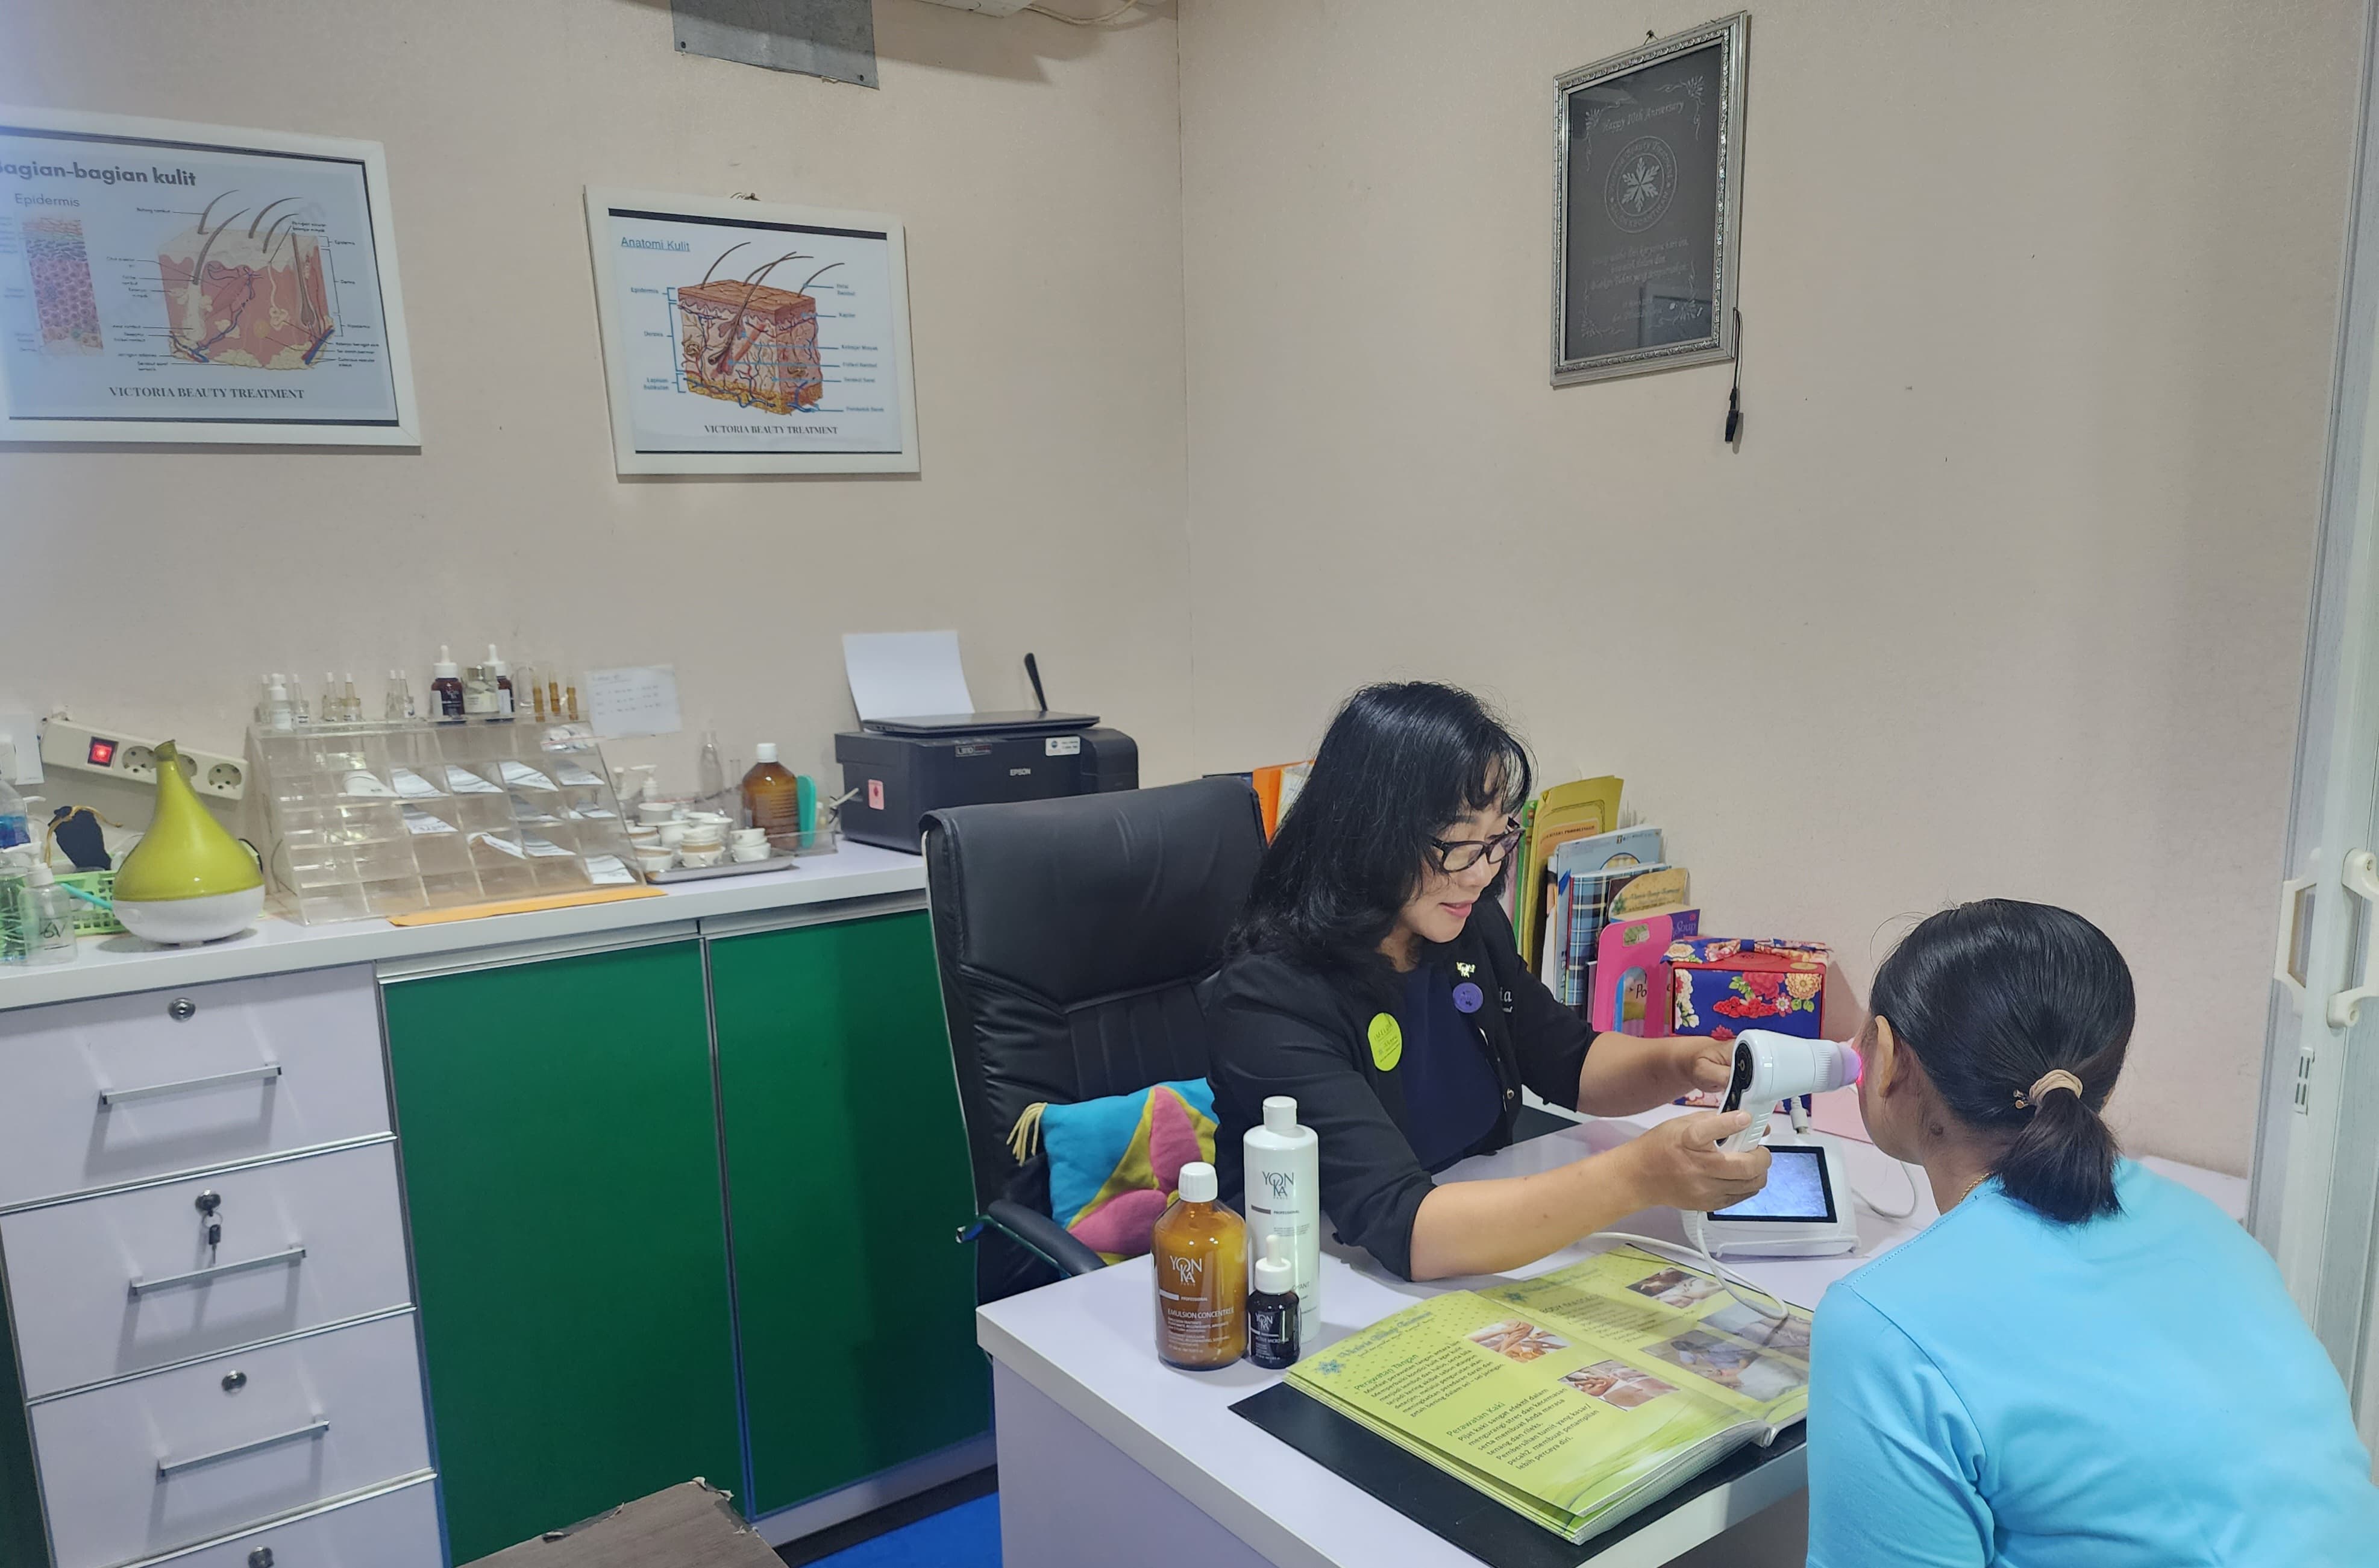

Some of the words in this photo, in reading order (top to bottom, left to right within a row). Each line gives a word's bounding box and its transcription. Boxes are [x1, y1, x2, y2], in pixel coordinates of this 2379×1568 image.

[152, 166, 196, 186] kulit
[14, 193, 80, 207] Epidermis
[621, 237, 663, 249] Anatomi
[666, 240, 690, 251] Kulit
[108, 387, 175, 397] VICTORIA
[178, 387, 227, 398] BEAUTY
[230, 388, 304, 399] TREATMENT
[704, 425, 750, 433] VICTORIA
[751, 425, 785, 434] BEAUTY
[787, 426, 838, 434] TREATMENT
[1675, 920, 1696, 935] Soup
[1168, 1308, 1197, 1319] EMULSION
[1353, 1368, 1394, 1390] Perawatan
[1391, 1354, 1418, 1369] Tangan
[1446, 1412, 1488, 1436] Perawatan
[1485, 1401, 1505, 1413] Kaki
[1457, 1431, 1475, 1441] Pijat
[1472, 1422, 1488, 1432] kaki
[1487, 1411, 1509, 1424] sangat
[1528, 1388, 1549, 1400] dalam
[1468, 1422, 1506, 1446] mengurangi
[1505, 1413, 1522, 1423] stres
[1521, 1406, 1534, 1414] dan
[1532, 1388, 1567, 1407] kecemasan
[1477, 1440, 1496, 1450] serta
[1494, 1421, 1526, 1440] membuat
[1525, 1411, 1543, 1423] Anda
[1541, 1399, 1565, 1413] merasa
[1496, 1435, 1539, 1460] Pembersihan
[1537, 1423, 1557, 1435] tumit
[1555, 1415, 1573, 1425] yang
[1532, 1431, 1564, 1450] membuat
[1562, 1410, 1599, 1432] penampilan
[1486, 1441, 1512, 1455] tenang
[1510, 1433, 1524, 1442] dan
[1515, 1458, 1535, 1470] lebih
[1534, 1444, 1559, 1461] percaya
